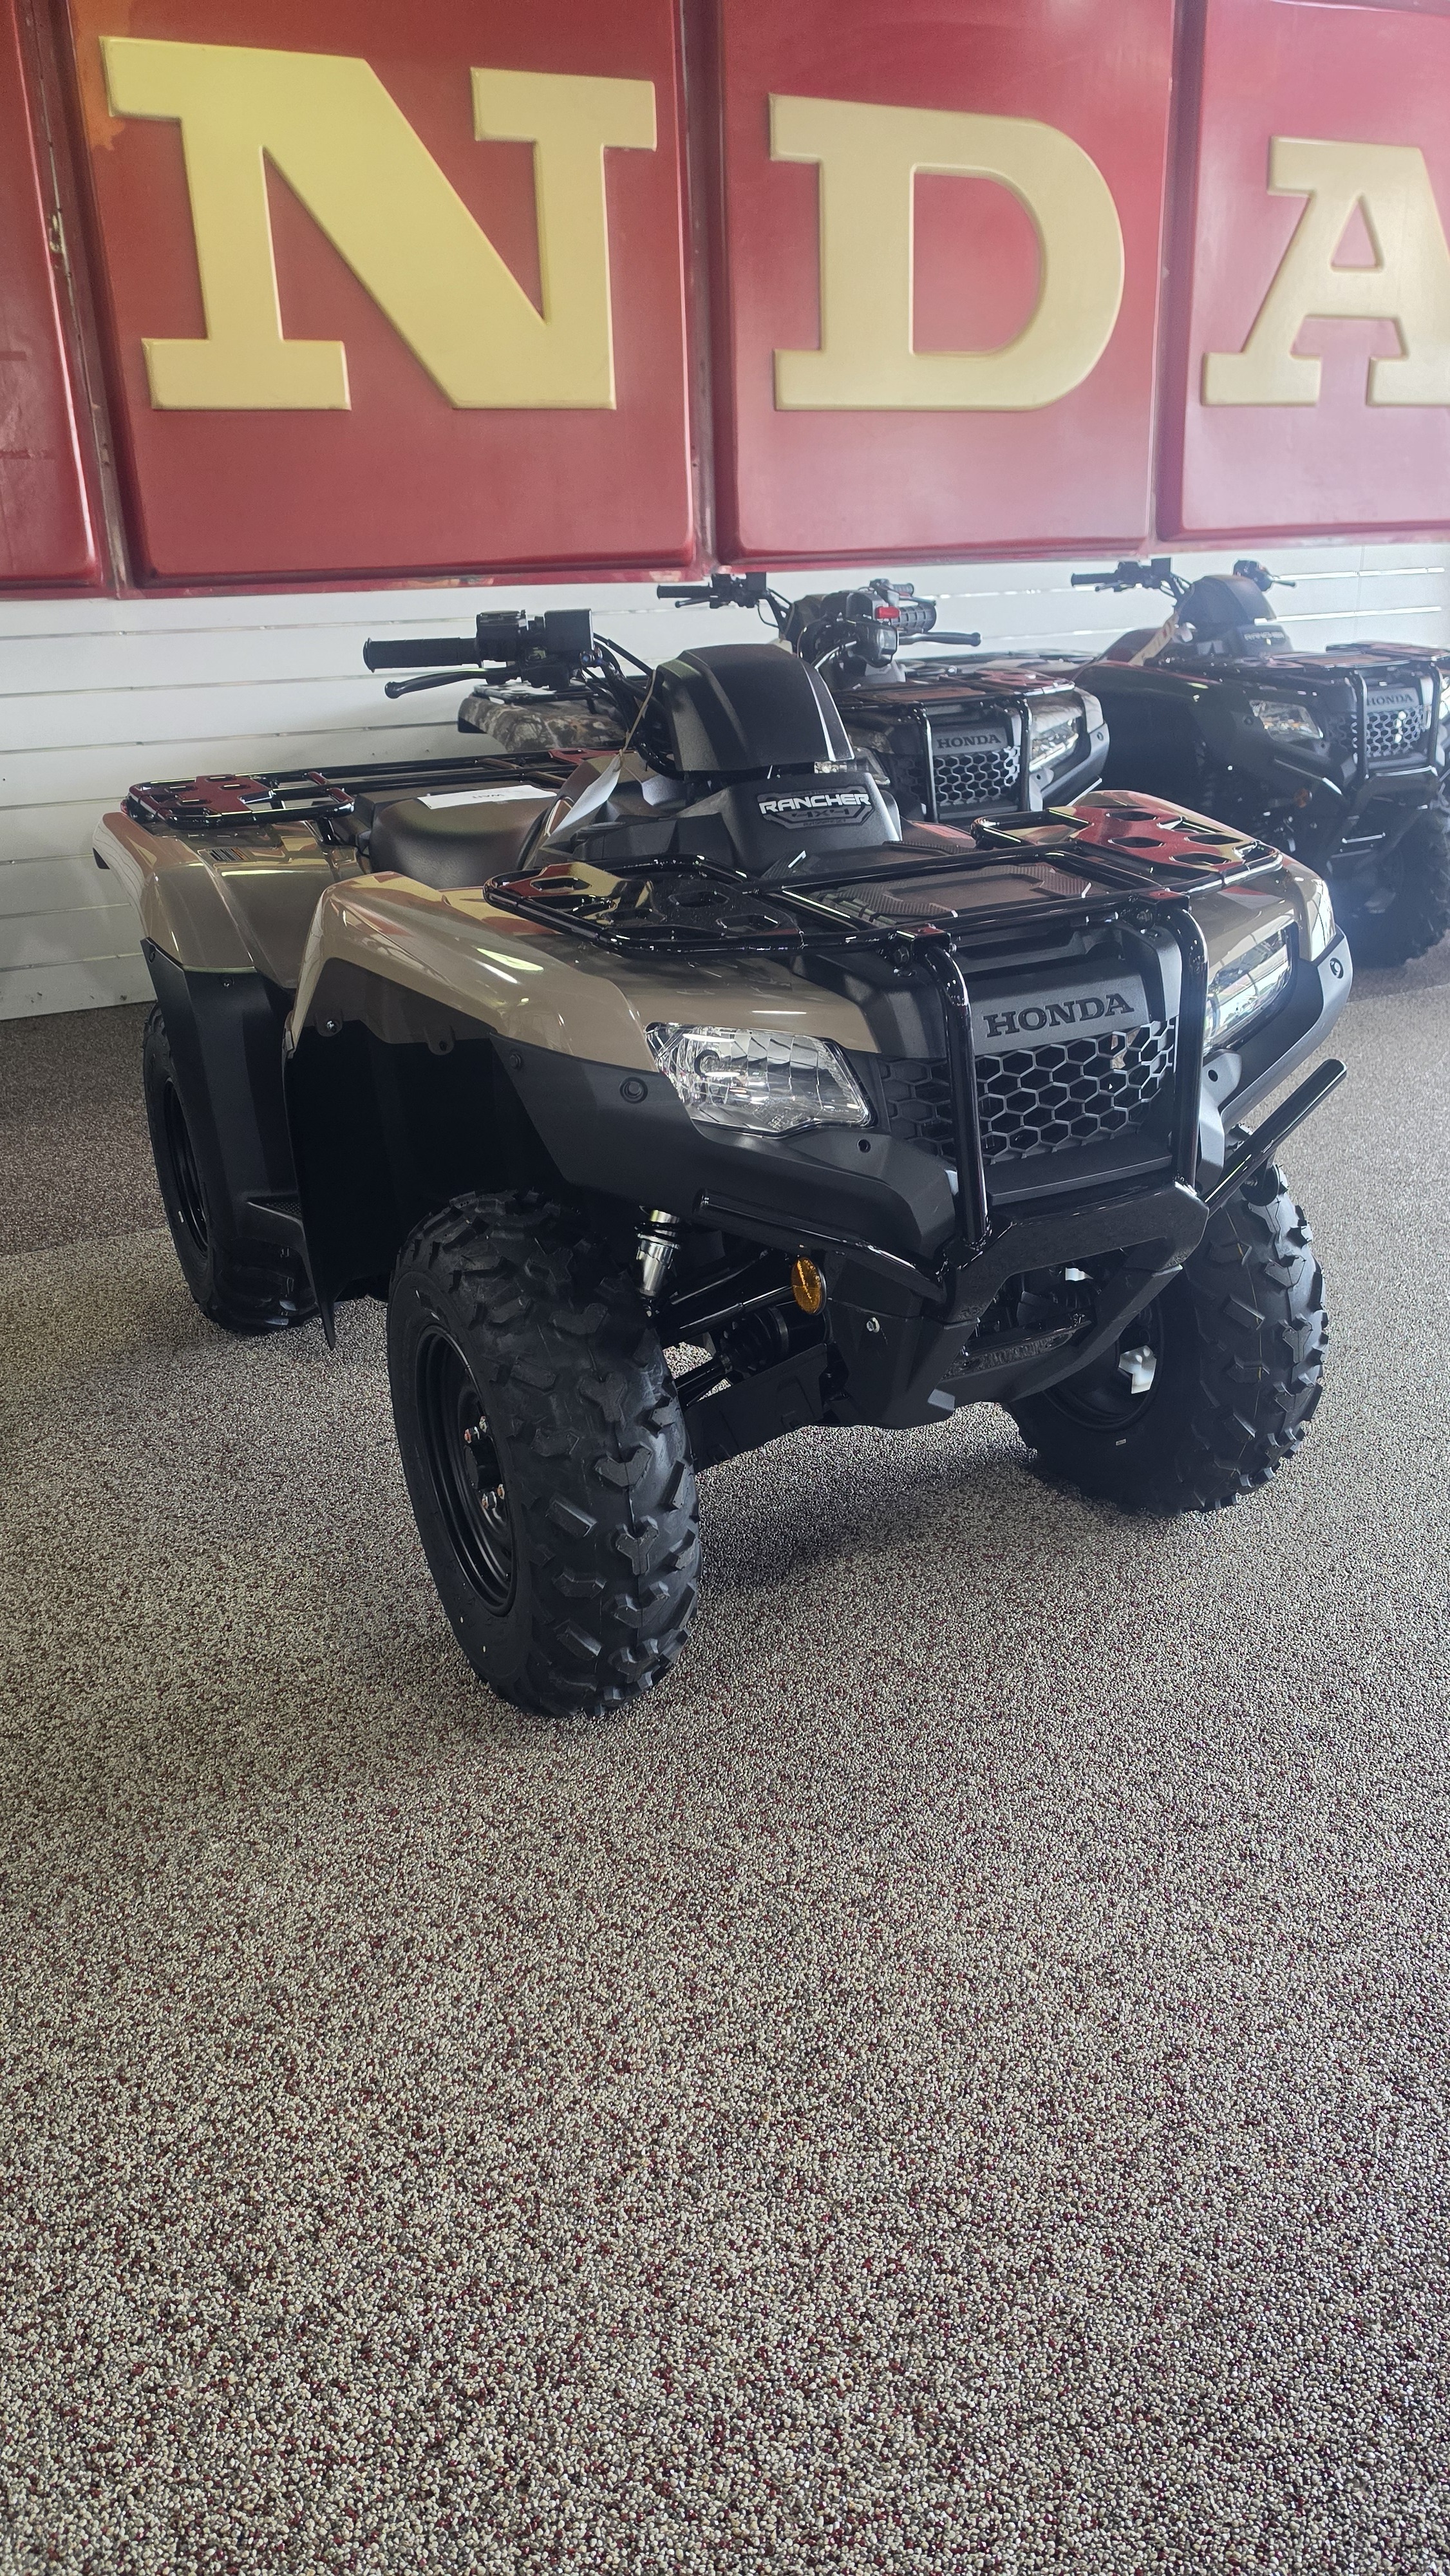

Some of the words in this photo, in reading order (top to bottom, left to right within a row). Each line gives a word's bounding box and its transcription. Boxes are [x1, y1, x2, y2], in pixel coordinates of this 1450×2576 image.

[1366, 693, 1414, 706] HONDA
[936, 734, 1002, 749] HONDA
[758, 793, 871, 815] RANCHER
[983, 992, 1135, 1038] HONDA
